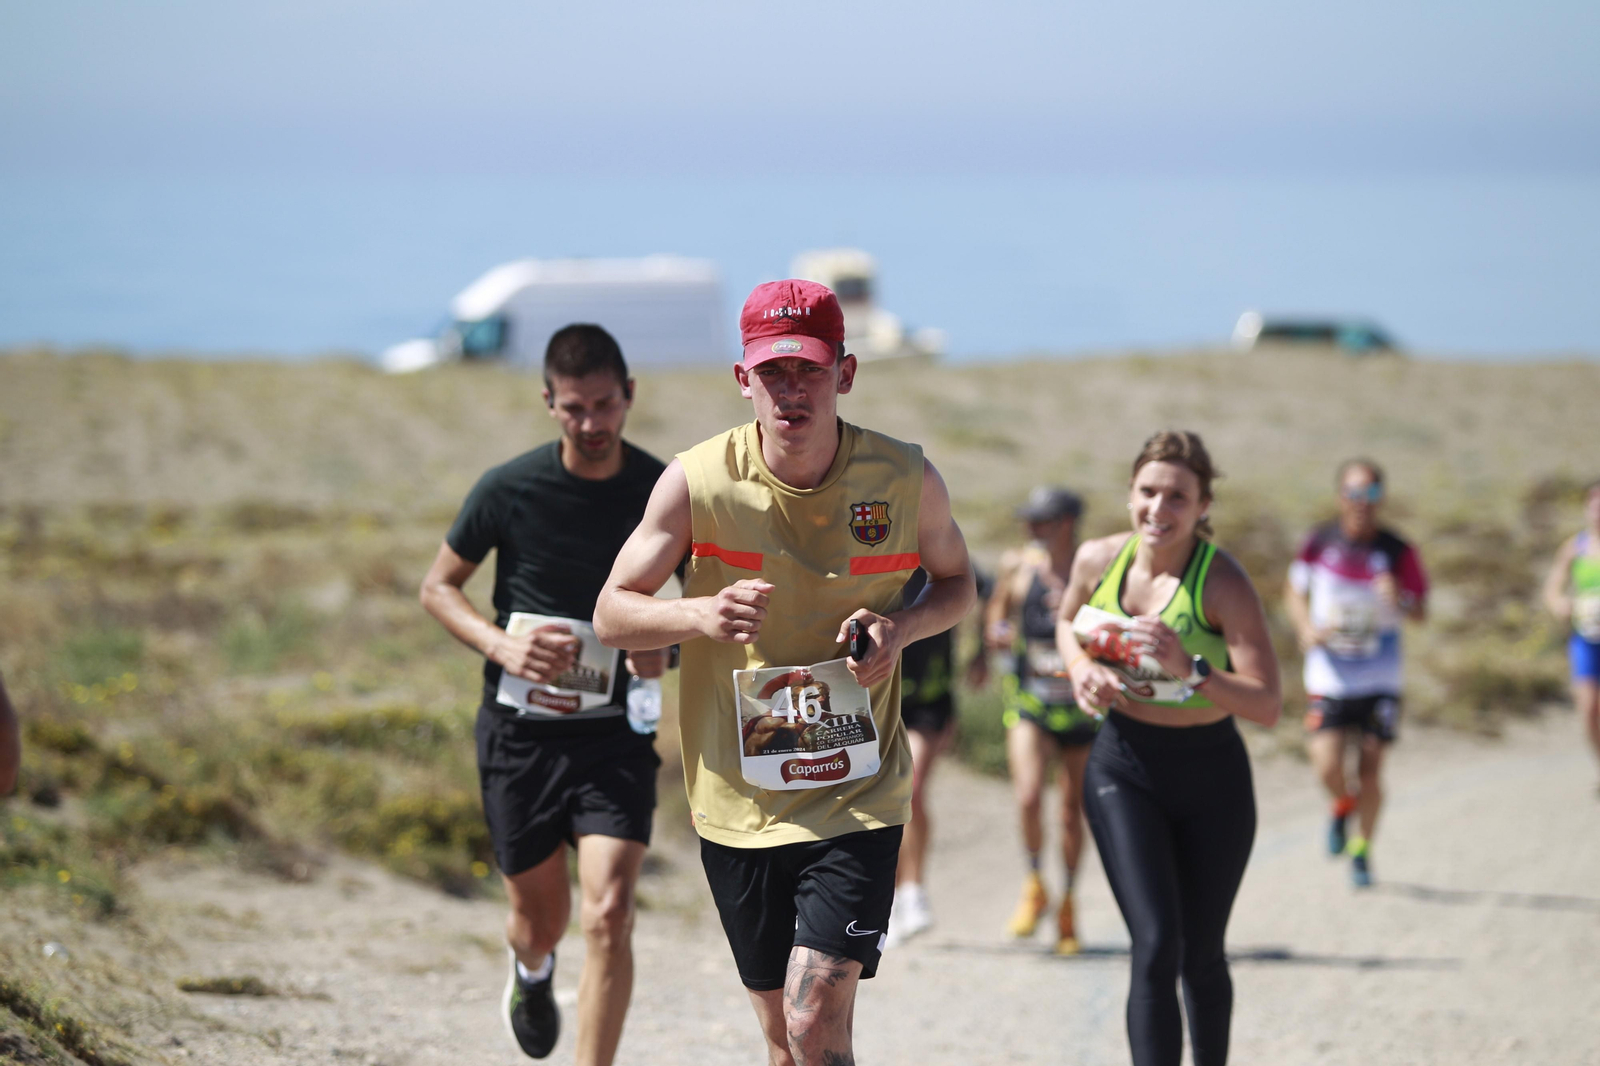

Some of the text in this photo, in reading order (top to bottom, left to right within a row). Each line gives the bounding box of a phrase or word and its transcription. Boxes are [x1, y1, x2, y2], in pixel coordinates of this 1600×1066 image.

[771, 686, 822, 724] 46
[815, 714, 859, 731] XIII
[816, 724, 861, 736] CARRERA
[817, 728, 863, 741] POPULAR
